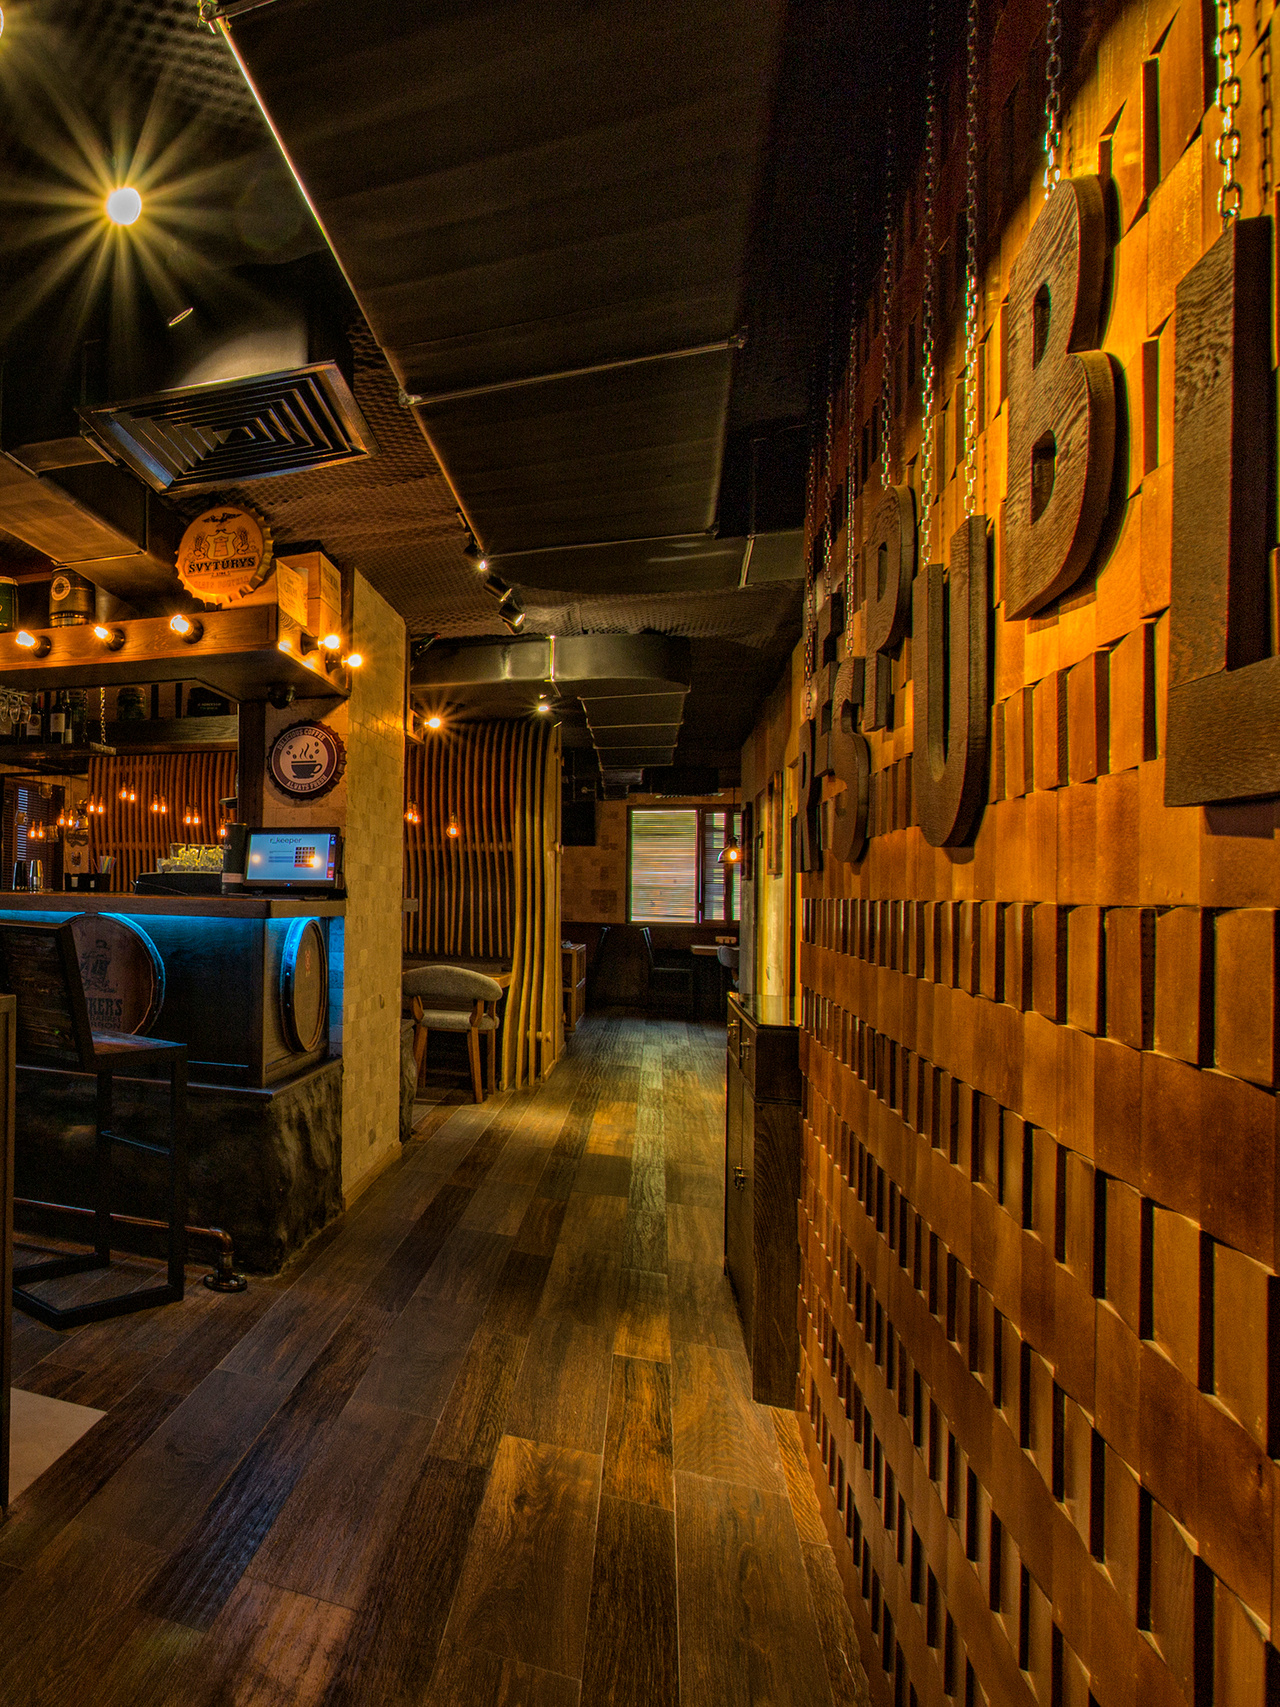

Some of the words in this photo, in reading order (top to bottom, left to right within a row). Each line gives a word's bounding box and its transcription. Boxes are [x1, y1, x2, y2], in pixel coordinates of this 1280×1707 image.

[276, 728, 304, 751] DELICIOUS
[303, 728, 326, 742] COFFEE
[286, 780, 310, 791] ALWAYS
[309, 774, 329, 789] FRESH
[269, 837, 303, 845] r_keeper
[86, 997, 123, 1017] KER'S
